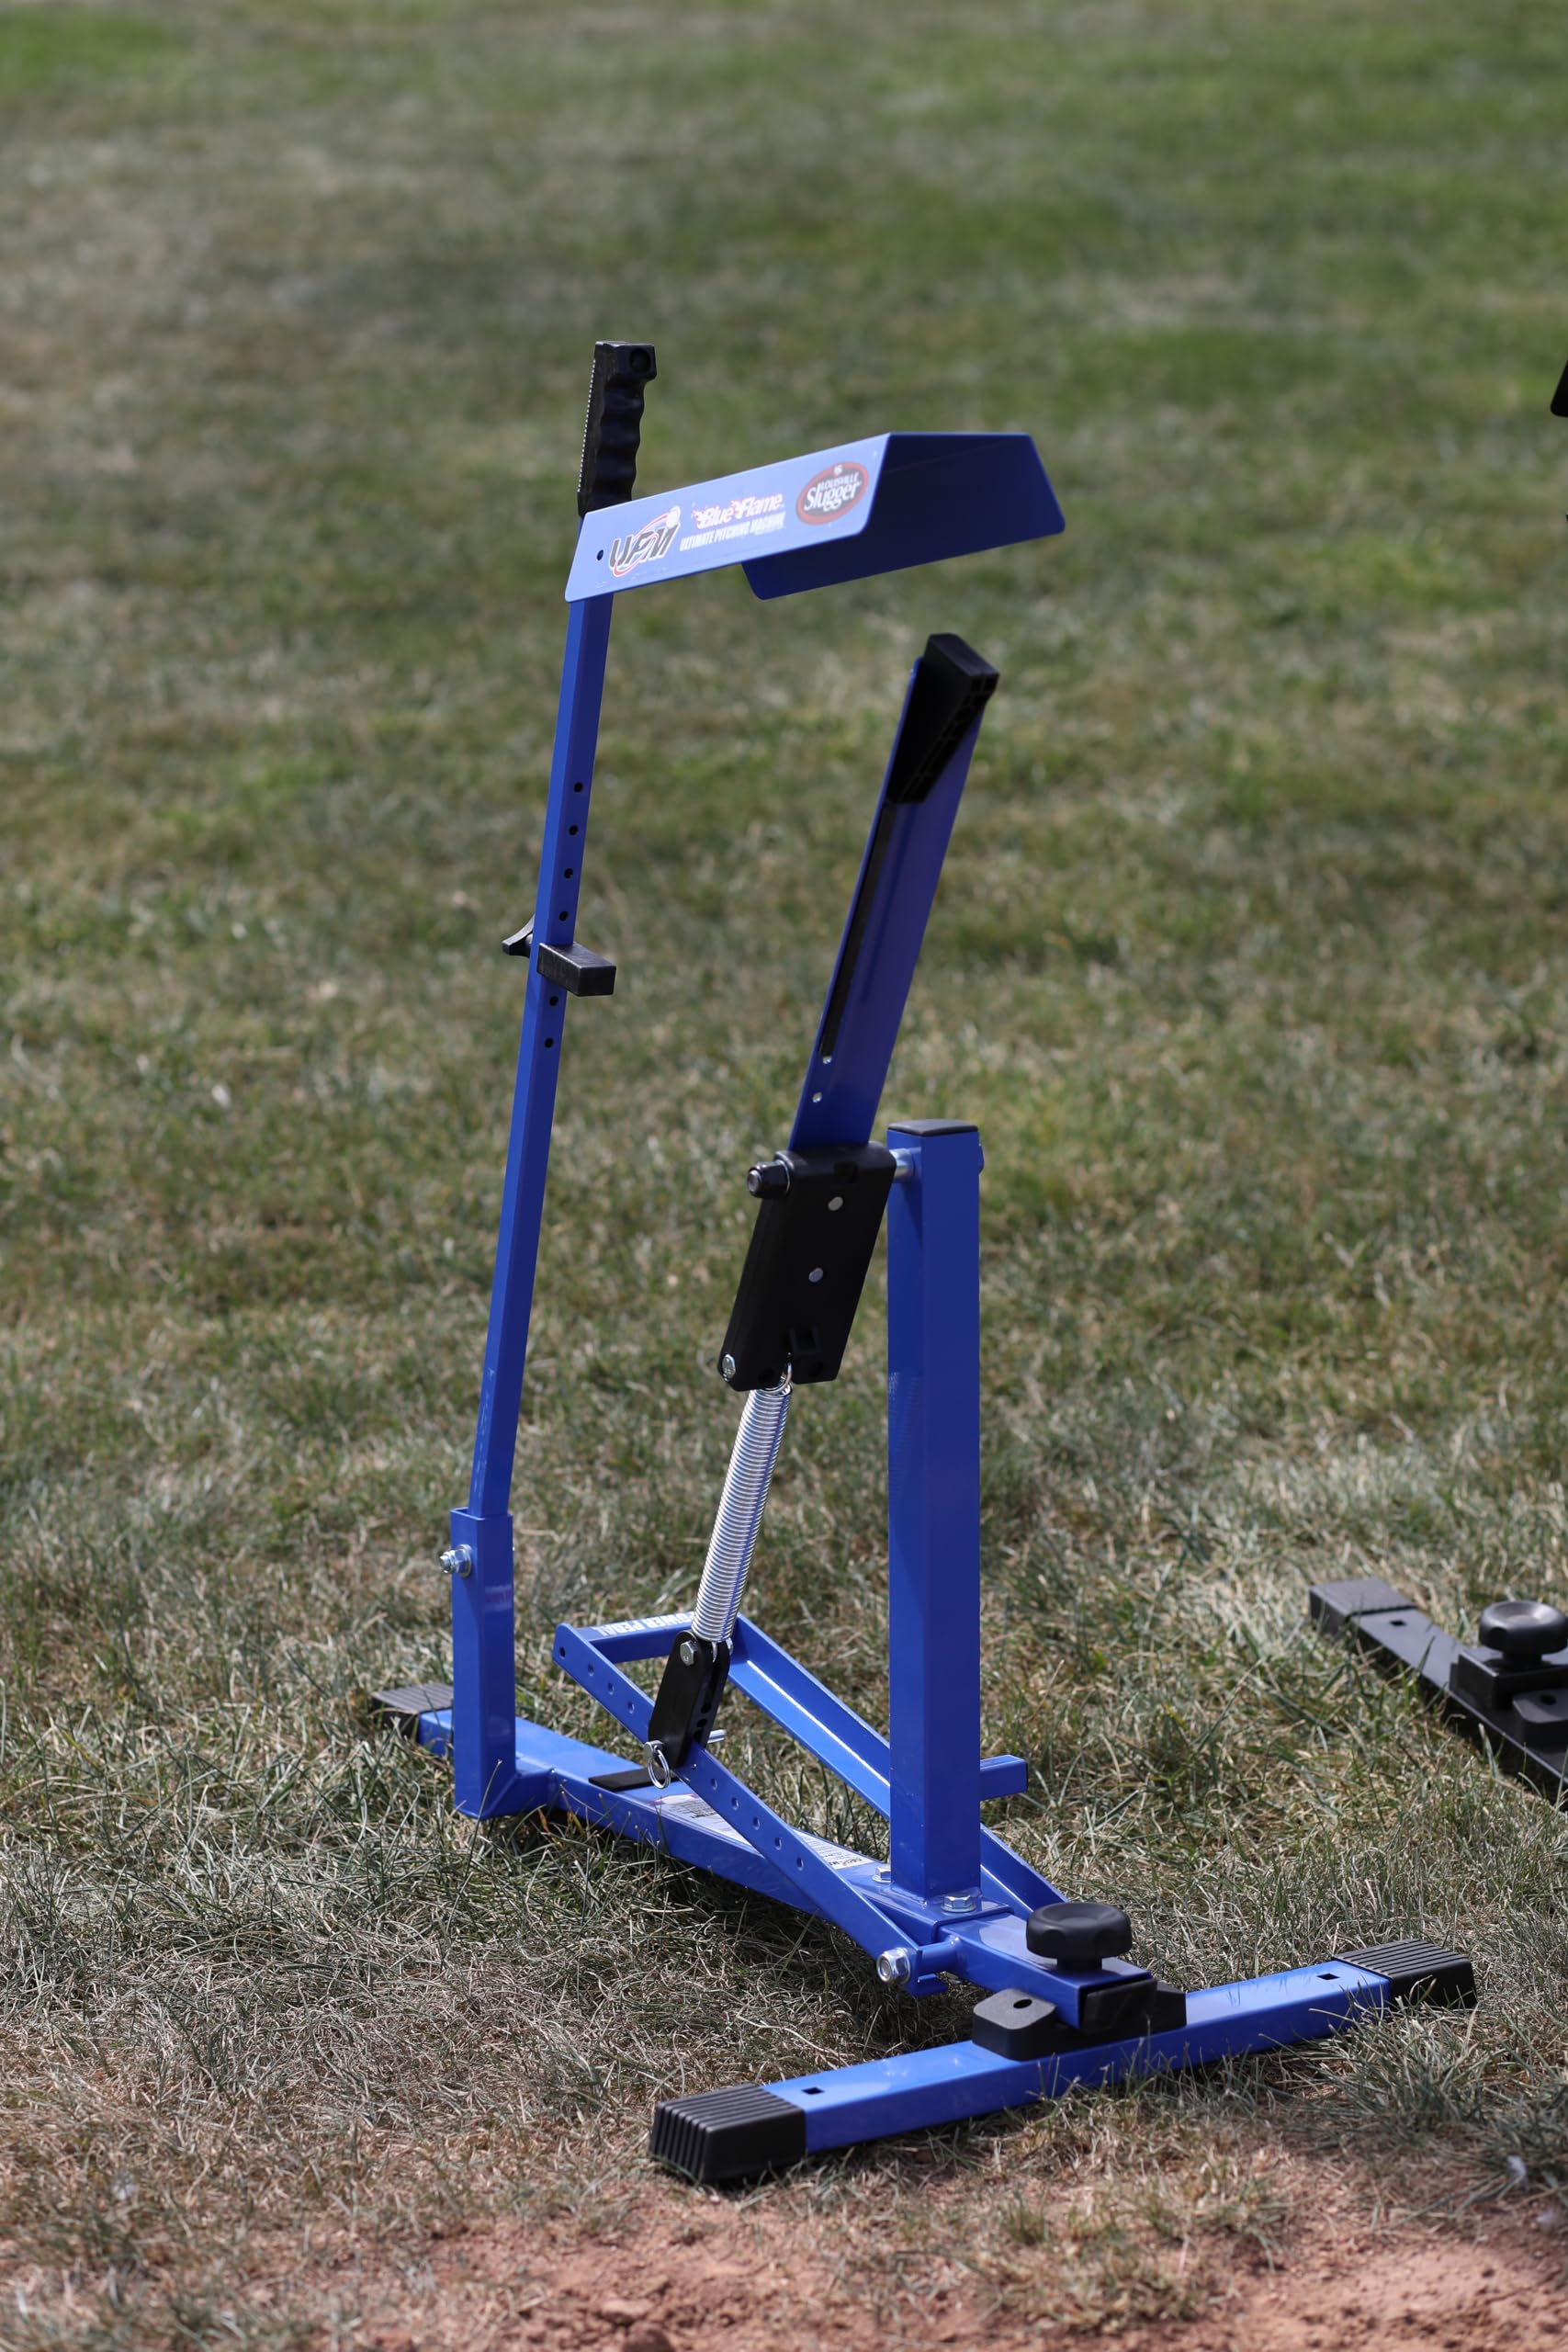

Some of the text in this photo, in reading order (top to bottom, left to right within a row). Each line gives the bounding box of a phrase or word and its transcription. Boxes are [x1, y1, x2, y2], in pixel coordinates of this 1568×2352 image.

[693, 493, 784, 529] Blue Flame
[804, 481, 862, 512] Slugger
[609, 522, 681, 568] UPM
[591, 1621, 646, 1636] PEDAL
